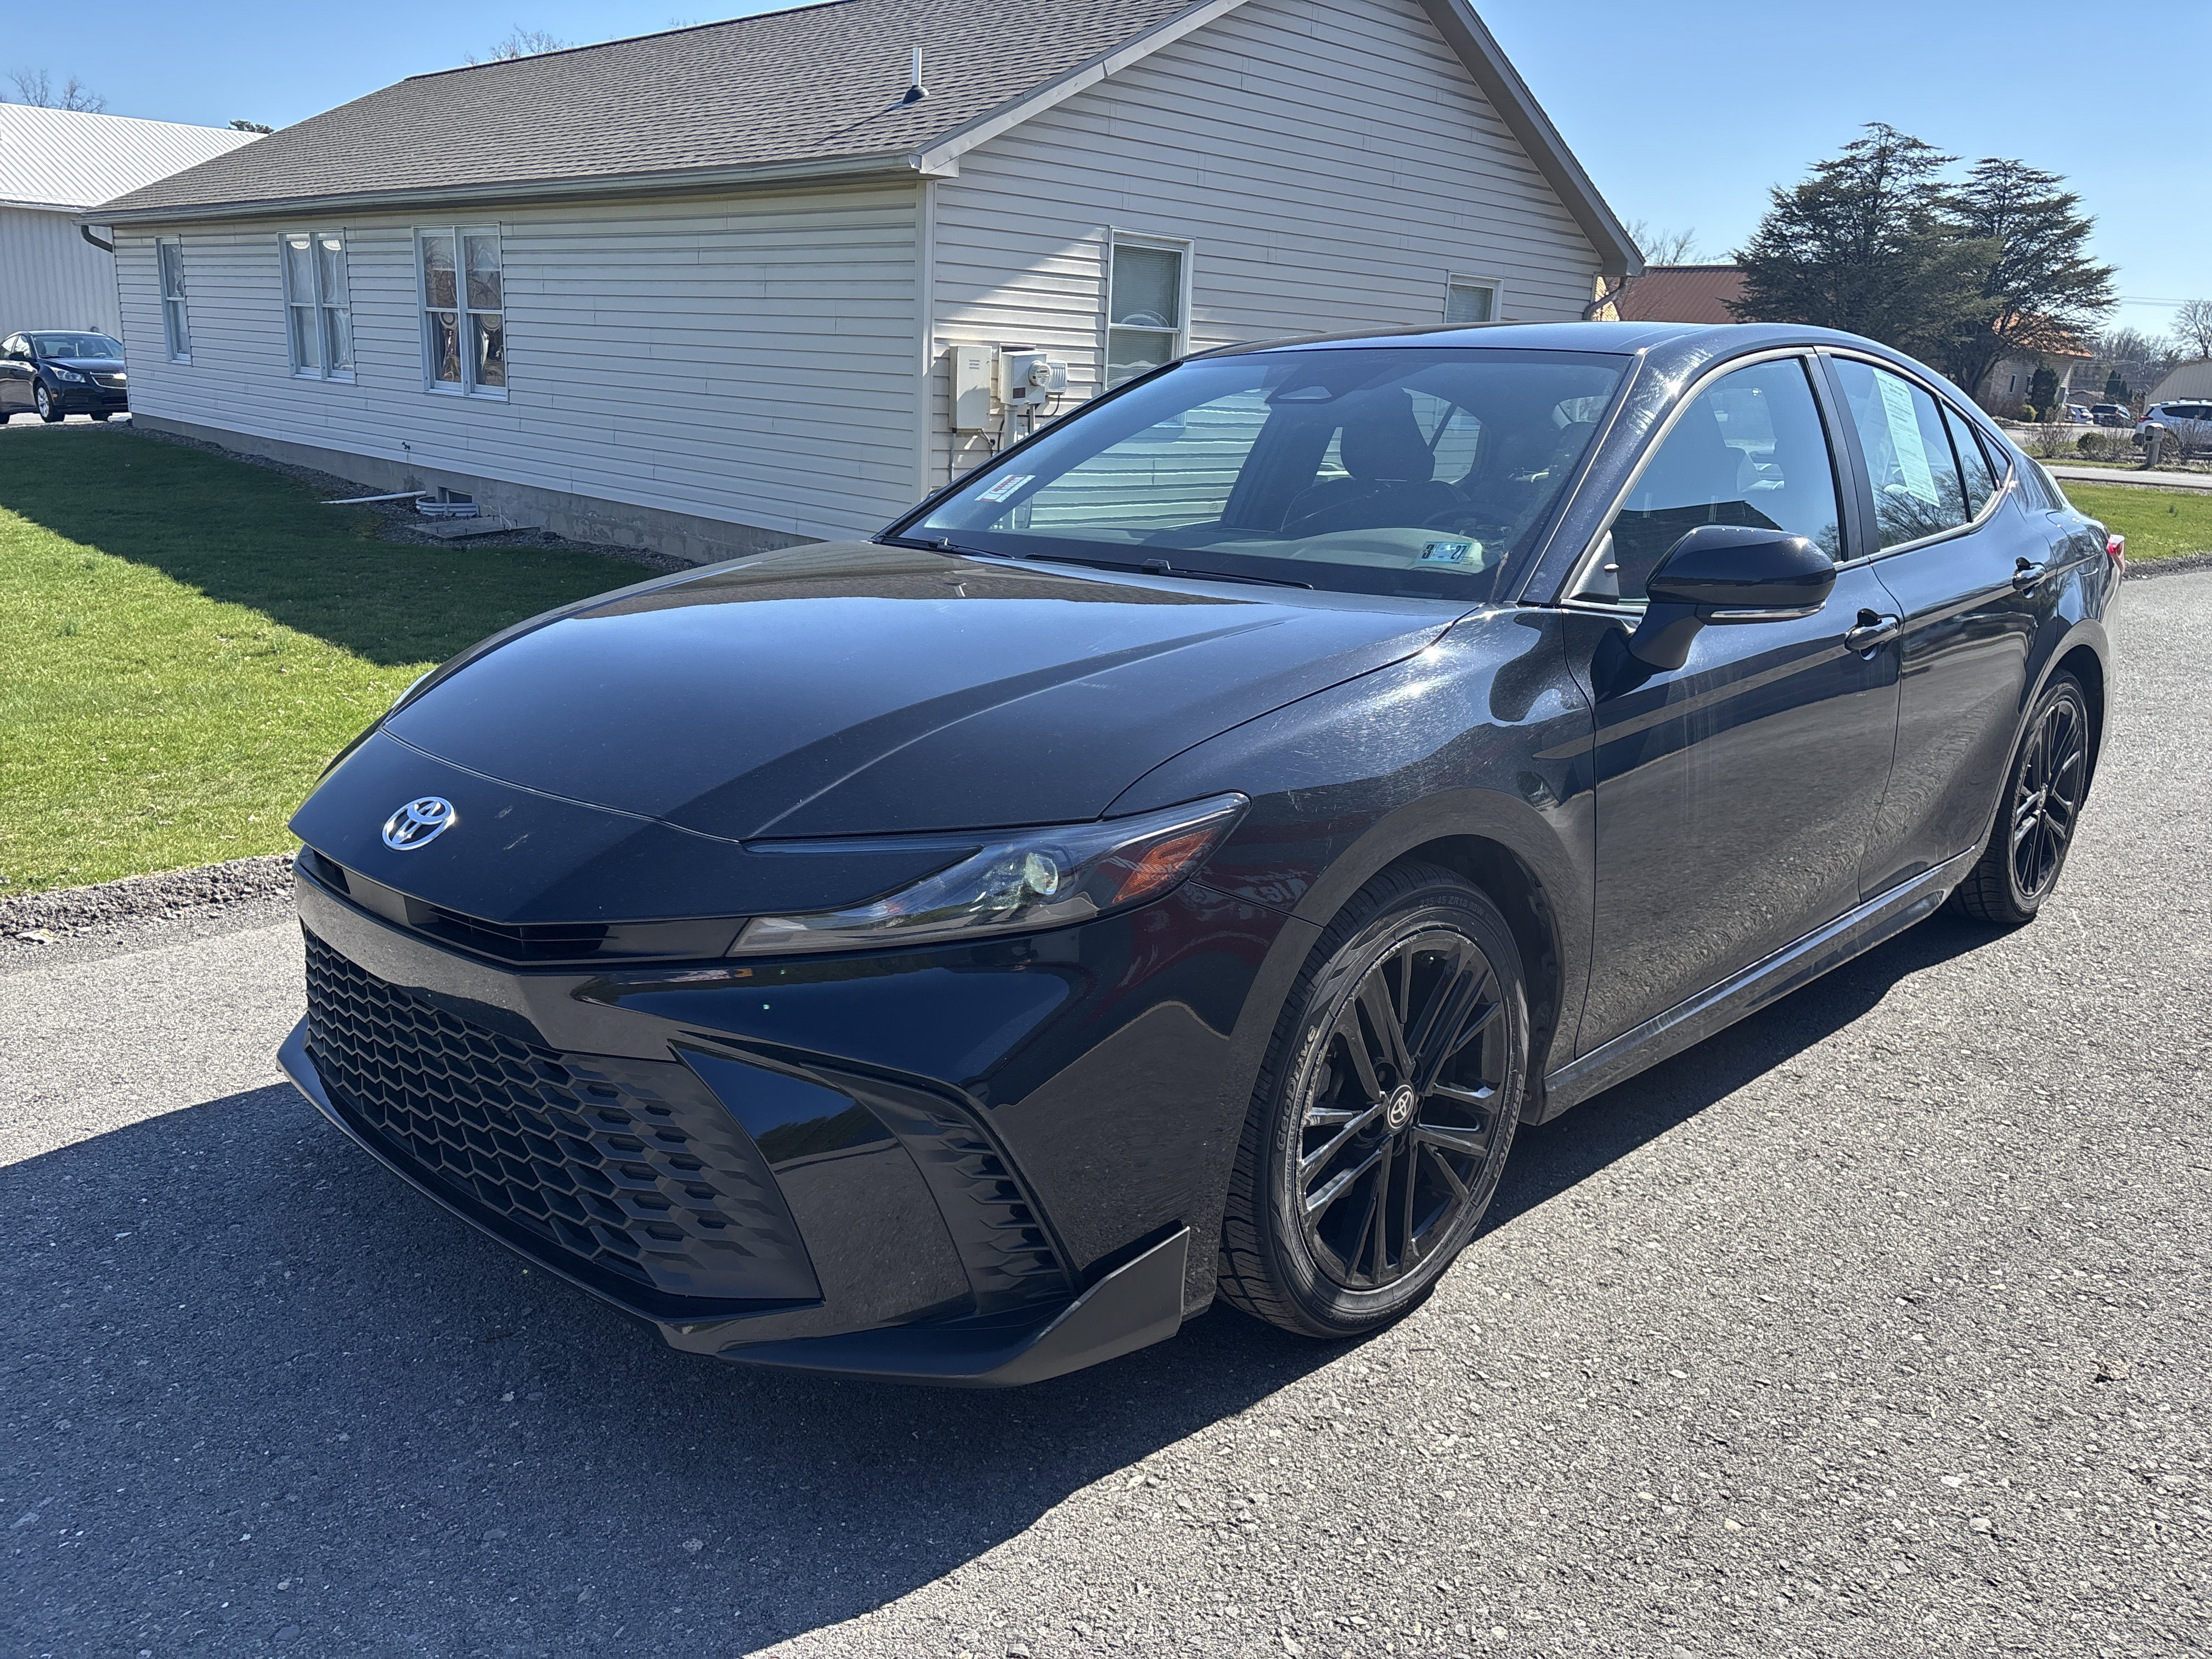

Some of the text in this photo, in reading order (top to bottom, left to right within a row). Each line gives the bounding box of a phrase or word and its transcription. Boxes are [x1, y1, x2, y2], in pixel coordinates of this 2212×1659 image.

[1421, 544, 1468, 560] 3 27
[1419, 896, 1447, 909] 235/45
[1276, 1025, 1317, 1151] GeoDrive
